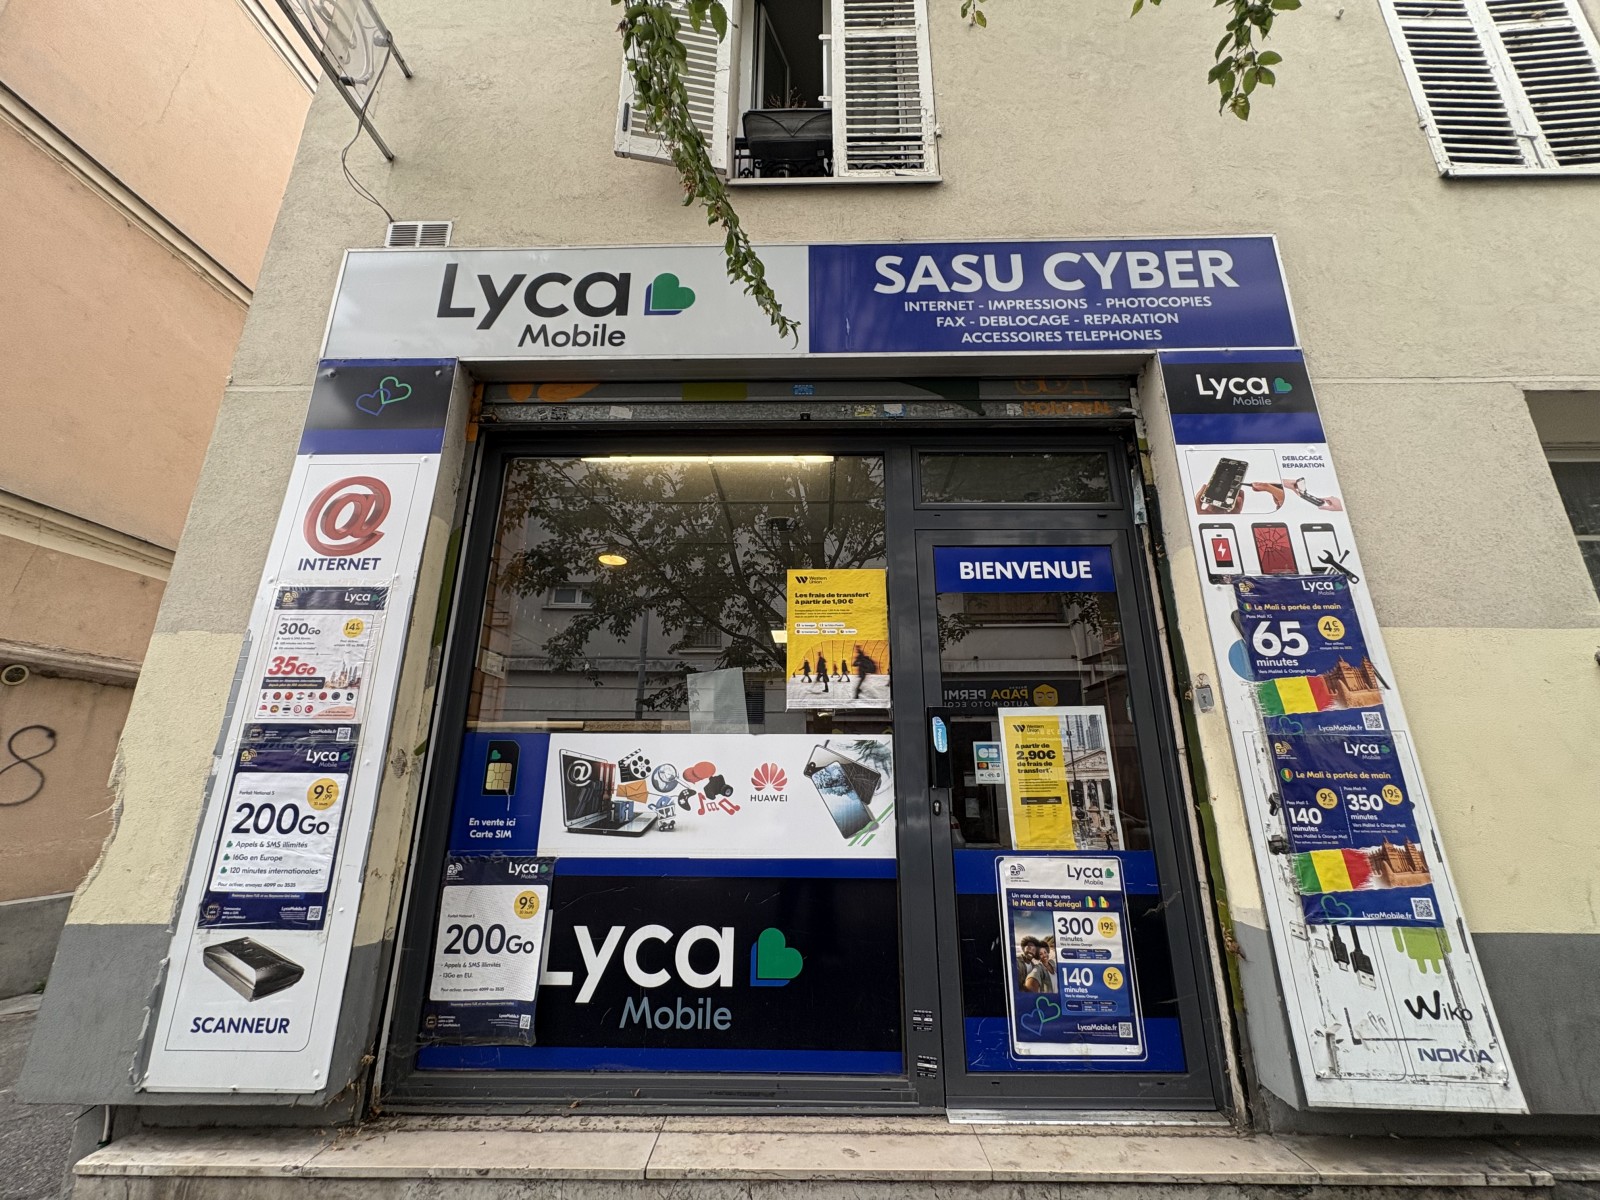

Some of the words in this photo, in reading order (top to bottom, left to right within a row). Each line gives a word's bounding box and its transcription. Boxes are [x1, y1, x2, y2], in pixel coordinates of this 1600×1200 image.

[873, 254, 1024, 294] SASU
[1043, 250, 1240, 291] CYBER
[437, 263, 631, 330] Lyca
[904, 300, 975, 312] INTERNET
[988, 298, 1088, 310] IMPRESSIONS
[1106, 296, 1212, 308] PHOTOCOPIES
[936, 316, 966, 327] FAX
[979, 314, 1070, 326] DEBLOCAGE
[1084, 313, 1179, 325] REPARATION
[517, 323, 626, 347] Mobile
[961, 331, 1063, 343] ACCESSOIRES
[1065, 329, 1163, 342] TELEPHONES
[1196, 374, 1270, 399] Lyca
[1233, 396, 1272, 406] Mobile
[297, 558, 382, 571] INTERNET
[959, 560, 1093, 580] BIENVENUE
[1301, 580, 1334, 593] Lyca
[344, 592, 371, 603] Lyca
[1287, 603, 1311, 611] portée
[278, 623, 321, 635] 300Go
[1252, 620, 1309, 657] 65
[267, 655, 317, 676] 35Go
[1256, 657, 1299, 667] minutes
[1318, 724, 1364, 732] LycaMobile.fr
[306, 749, 340, 763] Lyca
[1016, 750, 1056, 761] 2,90€
[1343, 742, 1380, 757] Lyca
[1295, 771, 1305, 779] Le
[1306, 771, 1323, 779] Mali
[1325, 770, 1332, 779] à
[1333, 770, 1358, 781] portée
[1359, 771, 1369, 779] de
[1371, 771, 1391, 779] main
[750, 794, 788, 802] HUAWEI
[1346, 794, 1384, 811] 350
[231, 802, 330, 835] 200Go
[469, 817, 480, 827] En
[481, 818, 505, 827] vente
[507, 817, 516, 827] ici
[1288, 807, 1323, 825] 140
[469, 829, 494, 839] Carte
[495, 829, 512, 839] SIM
[235, 841, 258, 849] Appels
[508, 862, 539, 876] Lyca
[1067, 864, 1103, 880] Lyca
[1054, 901, 1082, 909] Sénégal
[1362, 911, 1413, 919] LycaMobile.fr
[1057, 917, 1094, 936] 300
[443, 923, 535, 955] 200Go
[539, 909, 735, 1003] Lyca
[1062, 967, 1094, 987] 140
[1064, 986, 1088, 994] minutes
[1404, 990, 1473, 1021] Wiko
[619, 996, 732, 1030] Mobile
[190, 1016, 291, 1034] SCANNEUR
[1077, 1023, 1118, 1032] LycaMobile.fr
[1417, 1048, 1495, 1064] NOKIA
